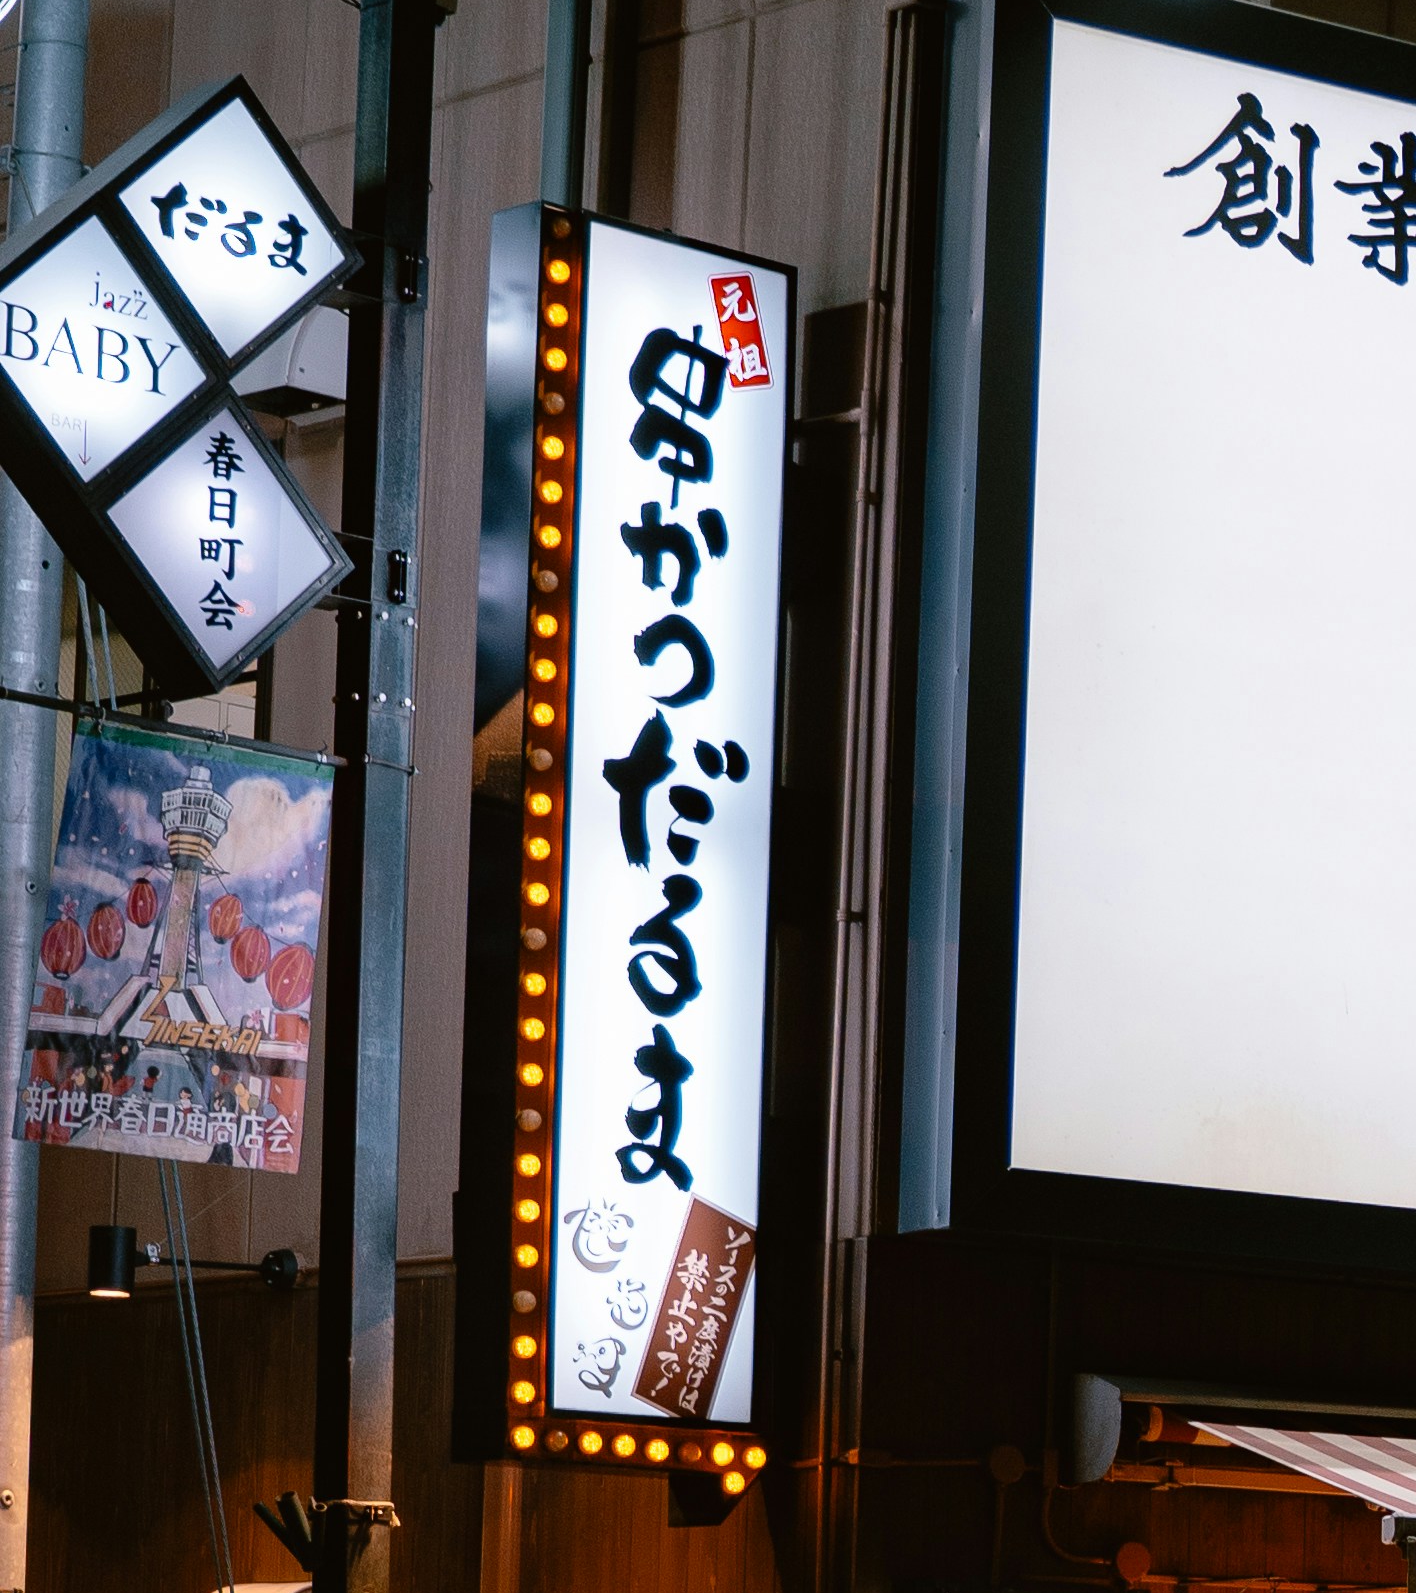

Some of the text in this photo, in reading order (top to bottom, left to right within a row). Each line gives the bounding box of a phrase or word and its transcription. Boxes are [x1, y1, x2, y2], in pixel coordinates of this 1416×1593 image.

[150, 182, 309, 276] だるま
[0, 301, 181, 396] BABY
[717, 276, 773, 385] 元祖
[51, 412, 83, 432] BAR
[198, 431, 246, 630] 春日町会
[603, 325, 750, 1193] 串かつだるま
[25, 1082, 294, 1154] 新世界春日通商店会
[678, 1225, 753, 1414] ソースの二度漬けは
